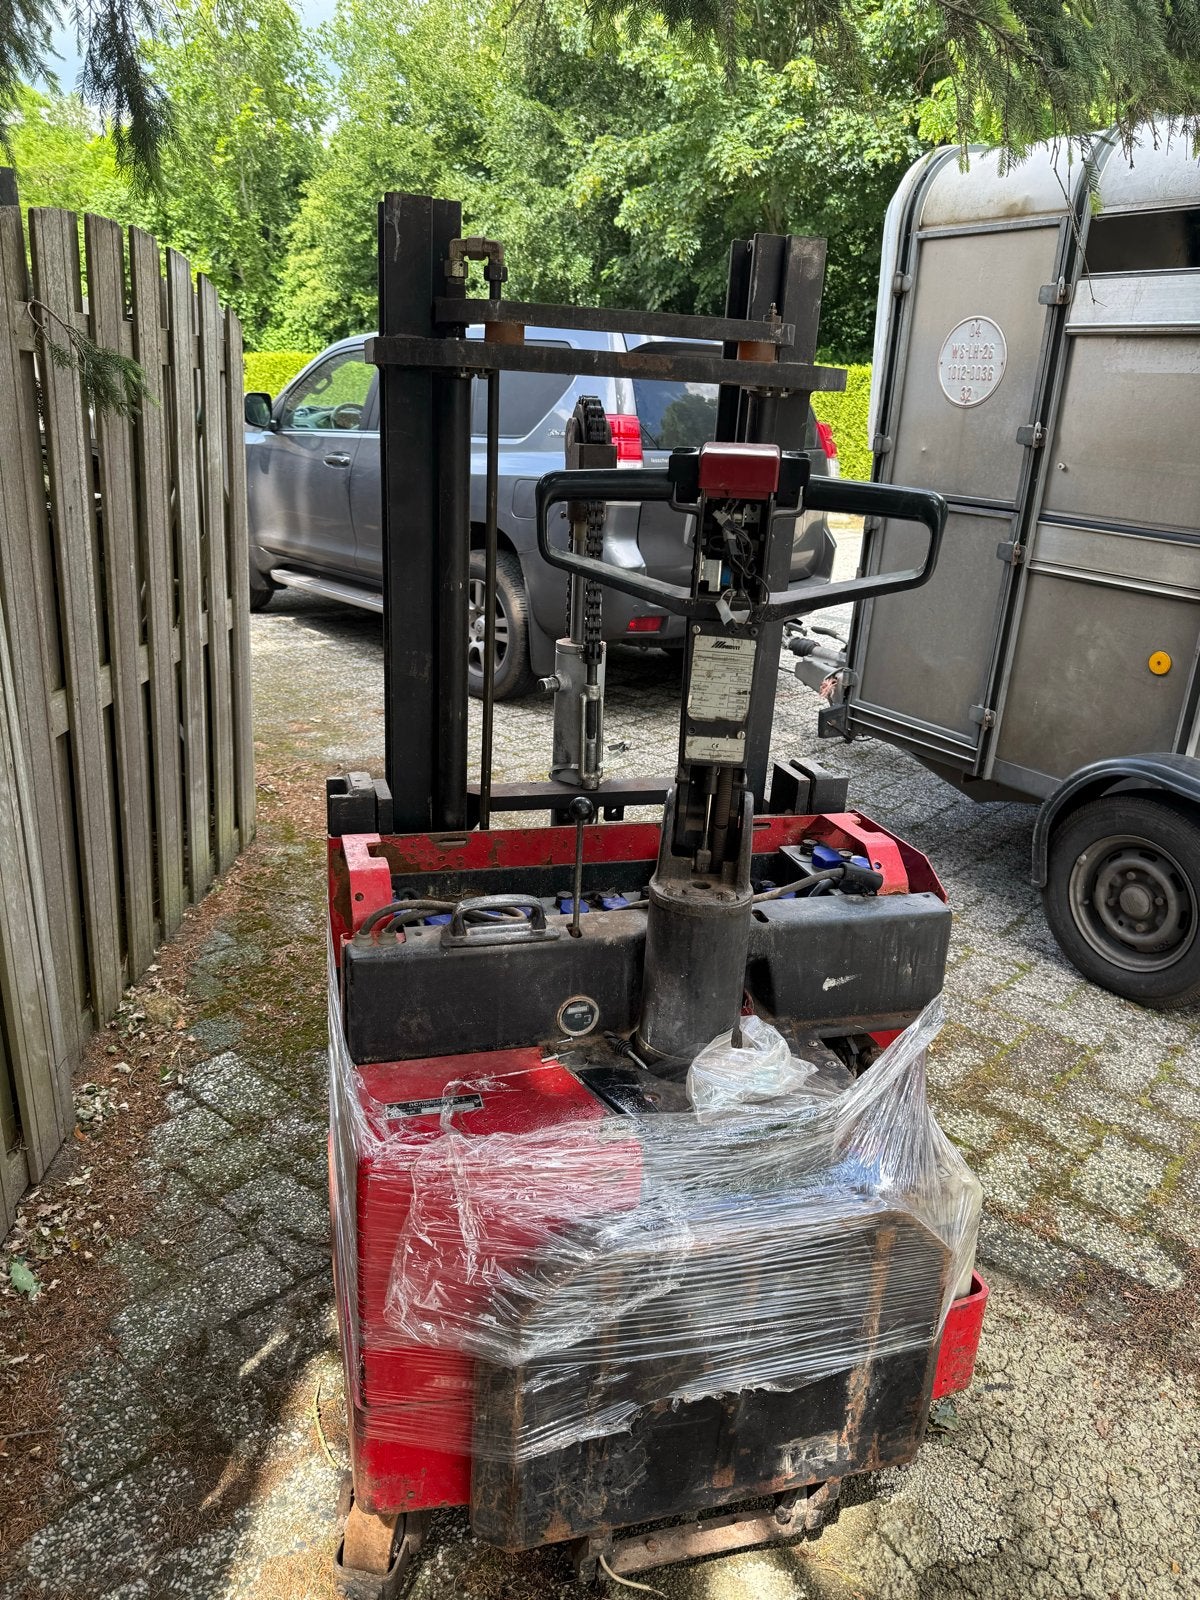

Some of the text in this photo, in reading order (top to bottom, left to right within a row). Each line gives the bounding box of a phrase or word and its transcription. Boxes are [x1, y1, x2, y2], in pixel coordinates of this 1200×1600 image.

[951, 343, 995, 360] WS-LH-26
[947, 364, 994, 382] 1012-0036
[960, 385, 974, 401] 32
